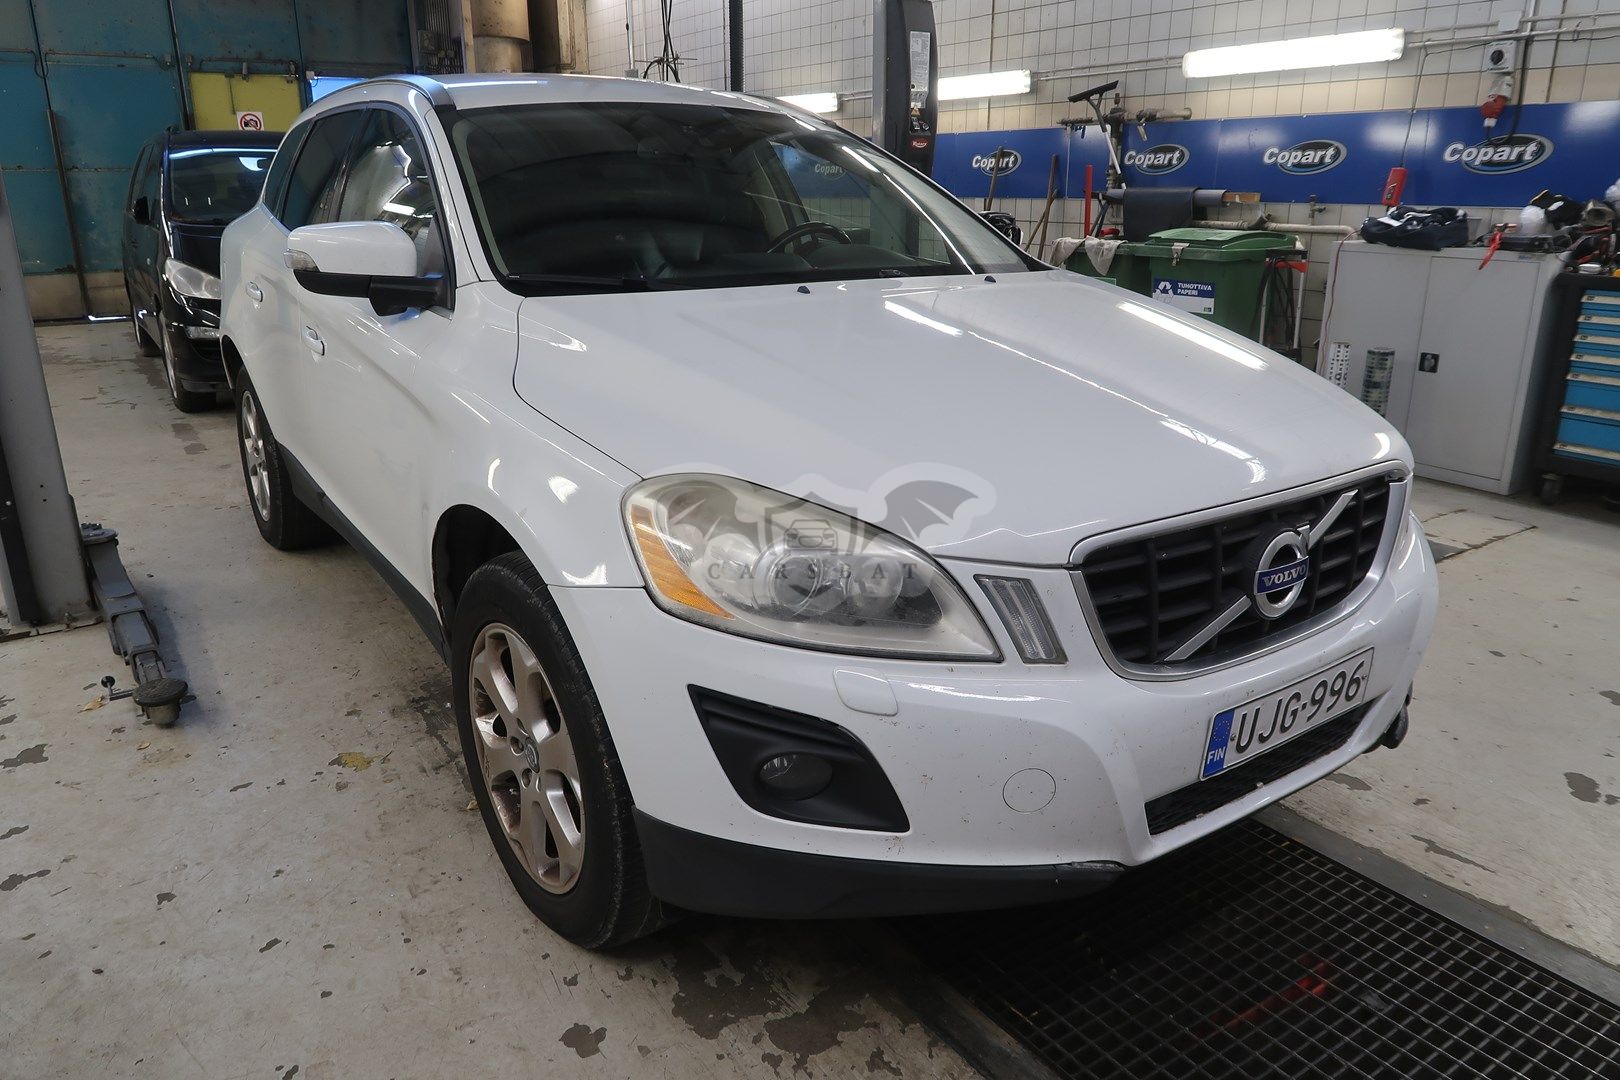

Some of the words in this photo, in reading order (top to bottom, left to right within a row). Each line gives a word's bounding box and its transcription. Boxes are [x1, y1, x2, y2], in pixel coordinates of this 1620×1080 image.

[1124, 144, 1181, 169] Copart
[1263, 146, 1337, 166] Copart
[1443, 139, 1541, 165] Copart
[1262, 564, 1307, 586] VOLVO
[1235, 660, 1365, 754] UJG-996
[1207, 746, 1226, 765] FIN
